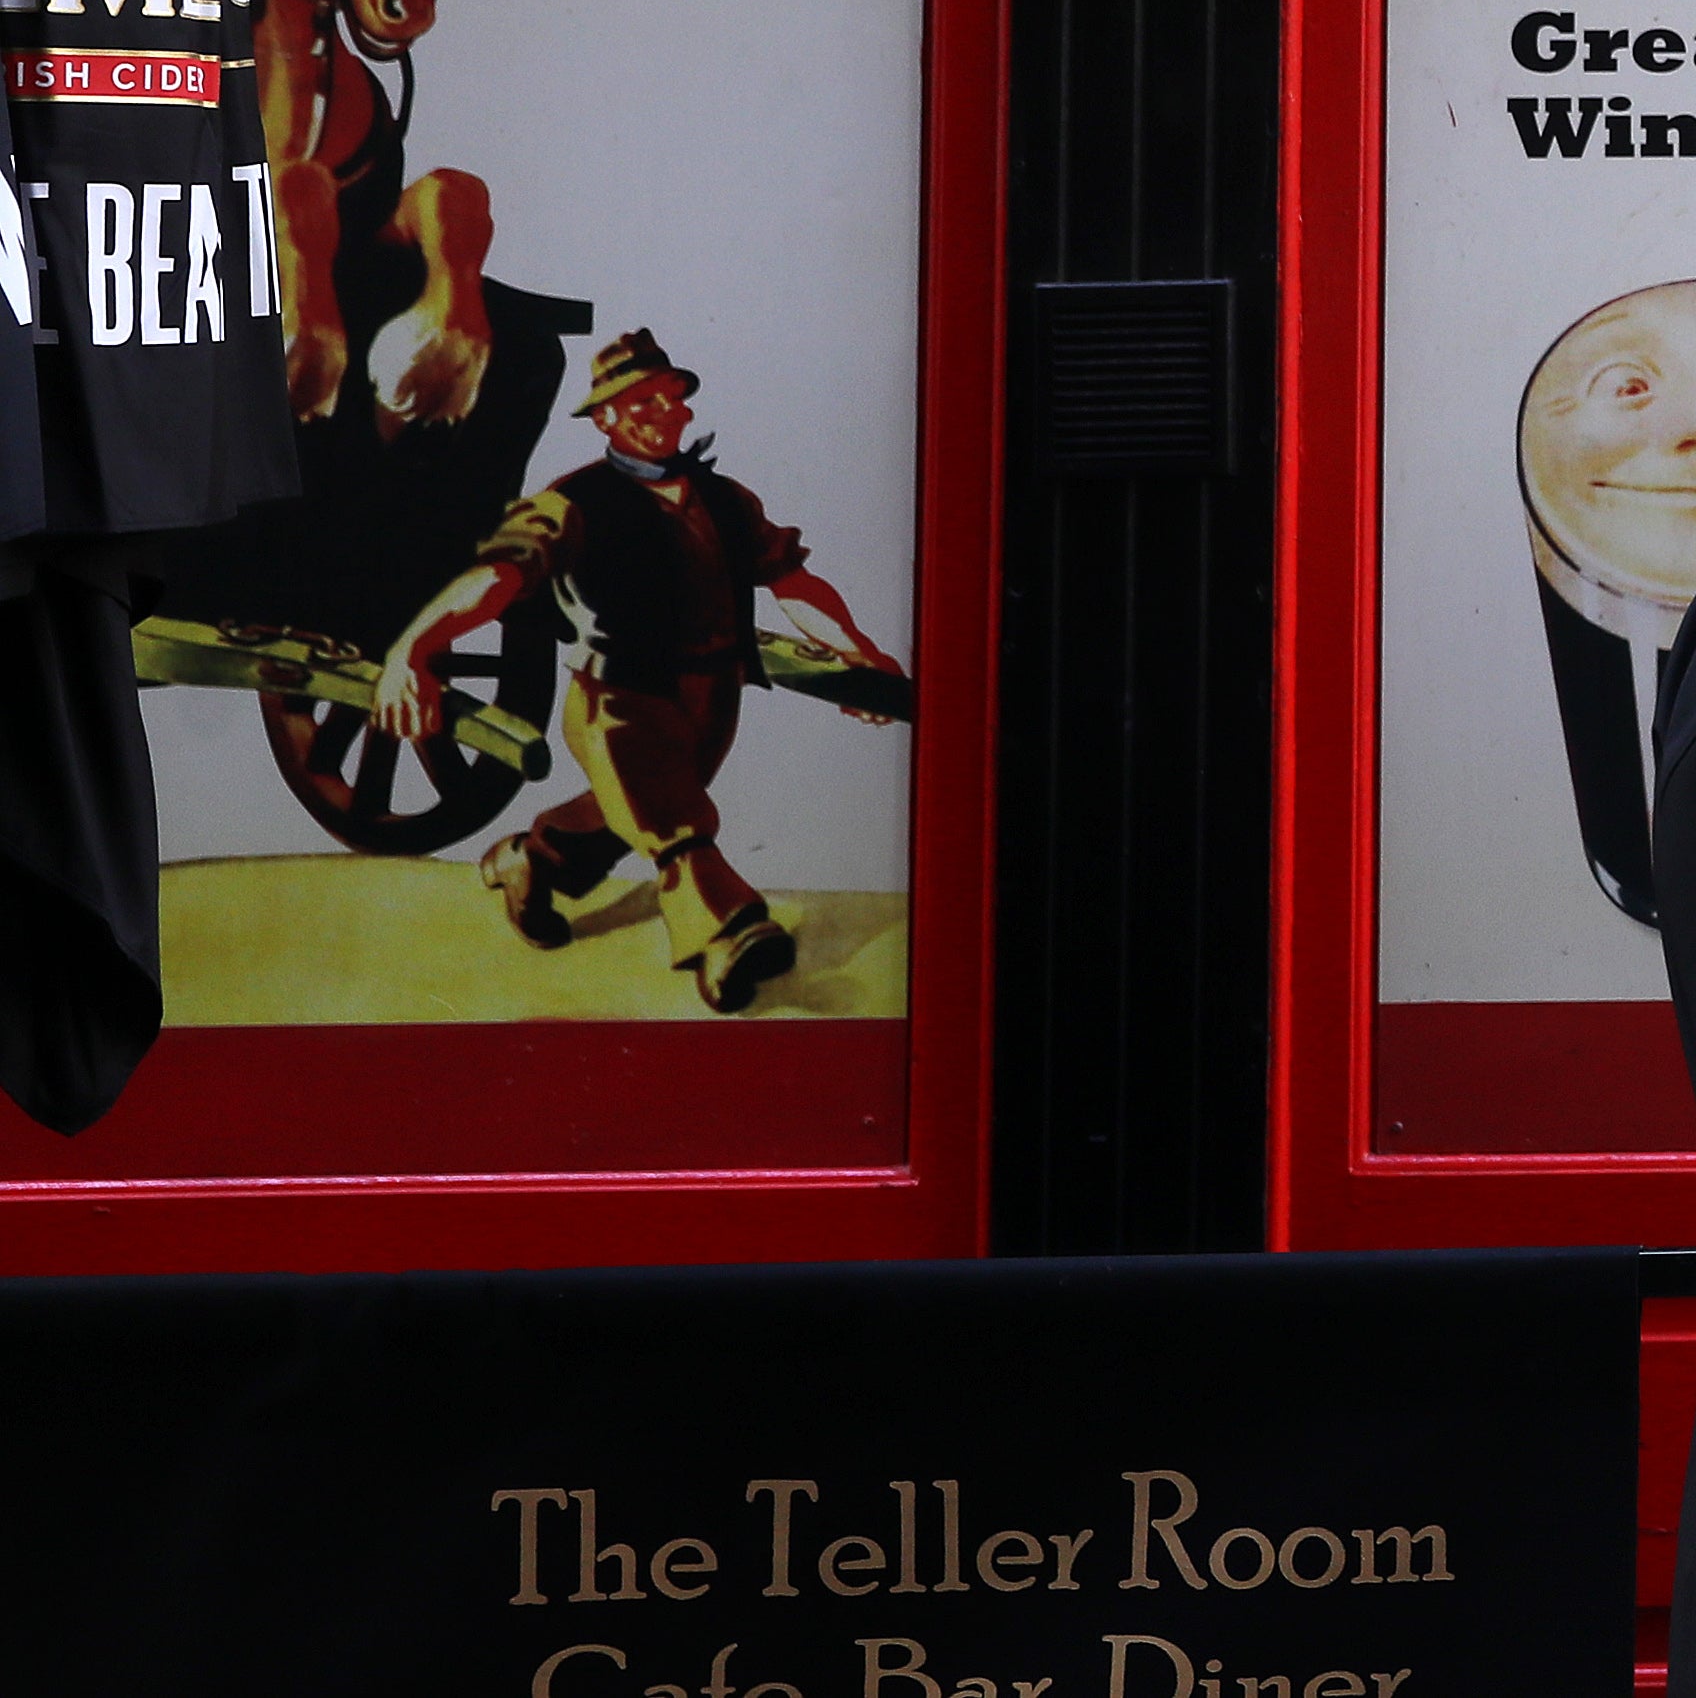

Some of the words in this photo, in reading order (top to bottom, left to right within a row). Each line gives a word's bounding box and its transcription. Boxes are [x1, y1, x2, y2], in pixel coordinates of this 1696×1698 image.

[491, 1487, 718, 1605] The
[747, 1479, 1094, 1596] Teller
[1119, 1469, 1455, 1590] Room
